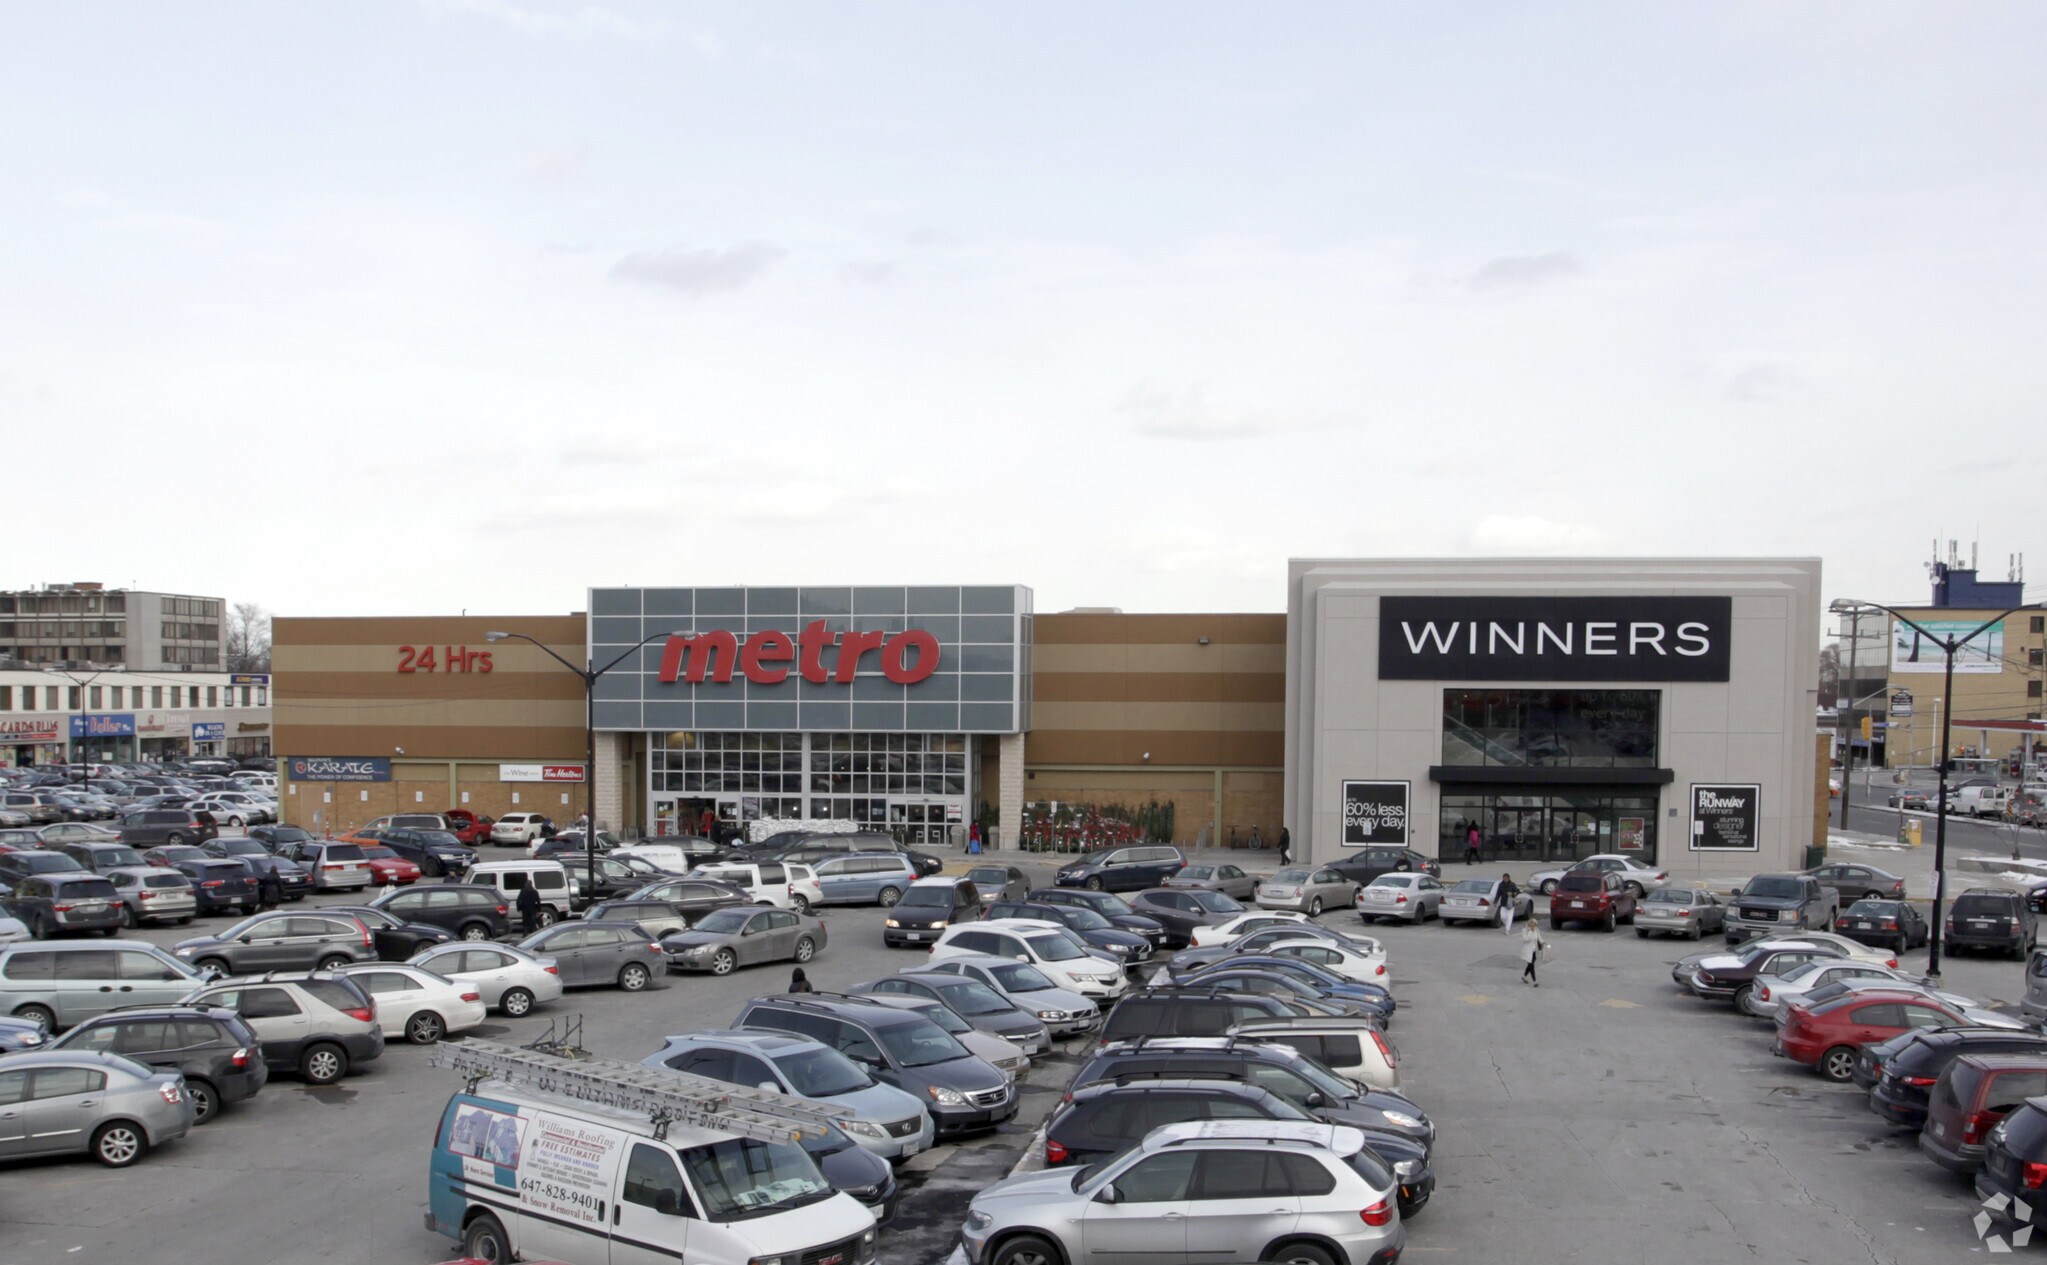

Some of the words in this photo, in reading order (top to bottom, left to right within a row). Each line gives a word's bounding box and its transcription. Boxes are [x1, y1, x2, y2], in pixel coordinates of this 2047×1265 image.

[1401, 620, 1711, 656] WINNERS
[398, 645, 437, 673] 24
[446, 645, 494, 673] Hrs
[658, 619, 941, 684] metro
[0, 721, 34, 733] CARDS
[36, 720, 58, 732] PLUS
[307, 762, 374, 774] KARATE
[544, 768, 557, 778] Tim
[557, 769, 582, 778] Hortons
[1699, 789, 1716, 799] the
[1699, 798, 1745, 808] RUNWAY
[1346, 802, 1376, 816] 60%
[1378, 802, 1405, 816] less.
[1381, 815, 1404, 830] day.
[538, 1119, 575, 1137] Williams
[578, 1129, 616, 1150] Roofing
[541, 1140, 558, 1153] FREE
[560, 1145, 601, 1162] ESTIMATES
[521, 1178, 598, 1211] 647-828-9401
[530, 1195, 548, 1209] Snow
[550, 1201, 580, 1220] Removal
